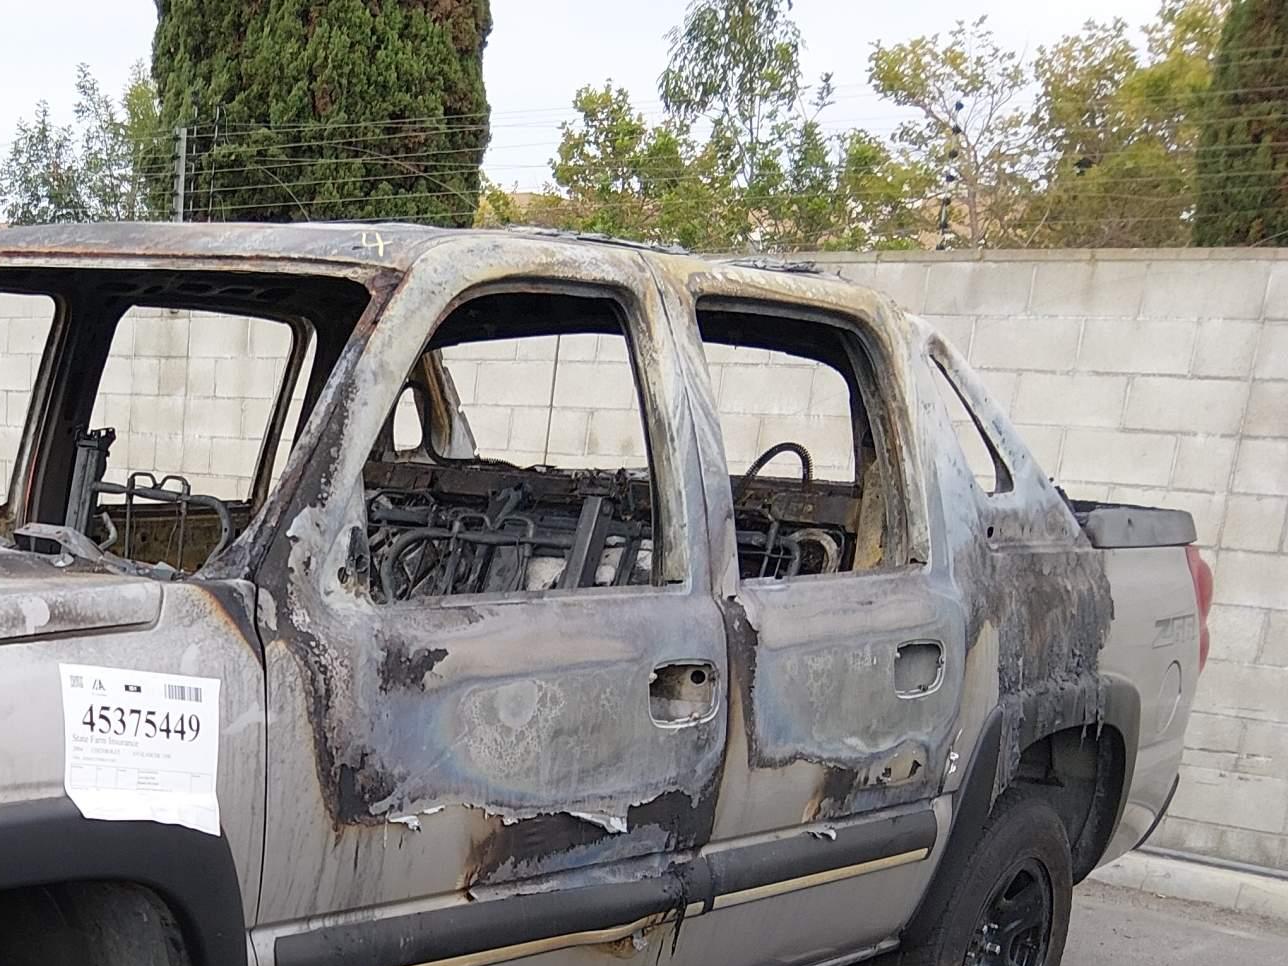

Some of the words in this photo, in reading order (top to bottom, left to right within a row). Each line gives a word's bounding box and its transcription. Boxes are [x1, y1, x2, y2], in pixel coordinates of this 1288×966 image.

[362, 231, 393, 257] 4
[81, 703, 201, 742] 45375449
[72, 732, 88, 743] State
